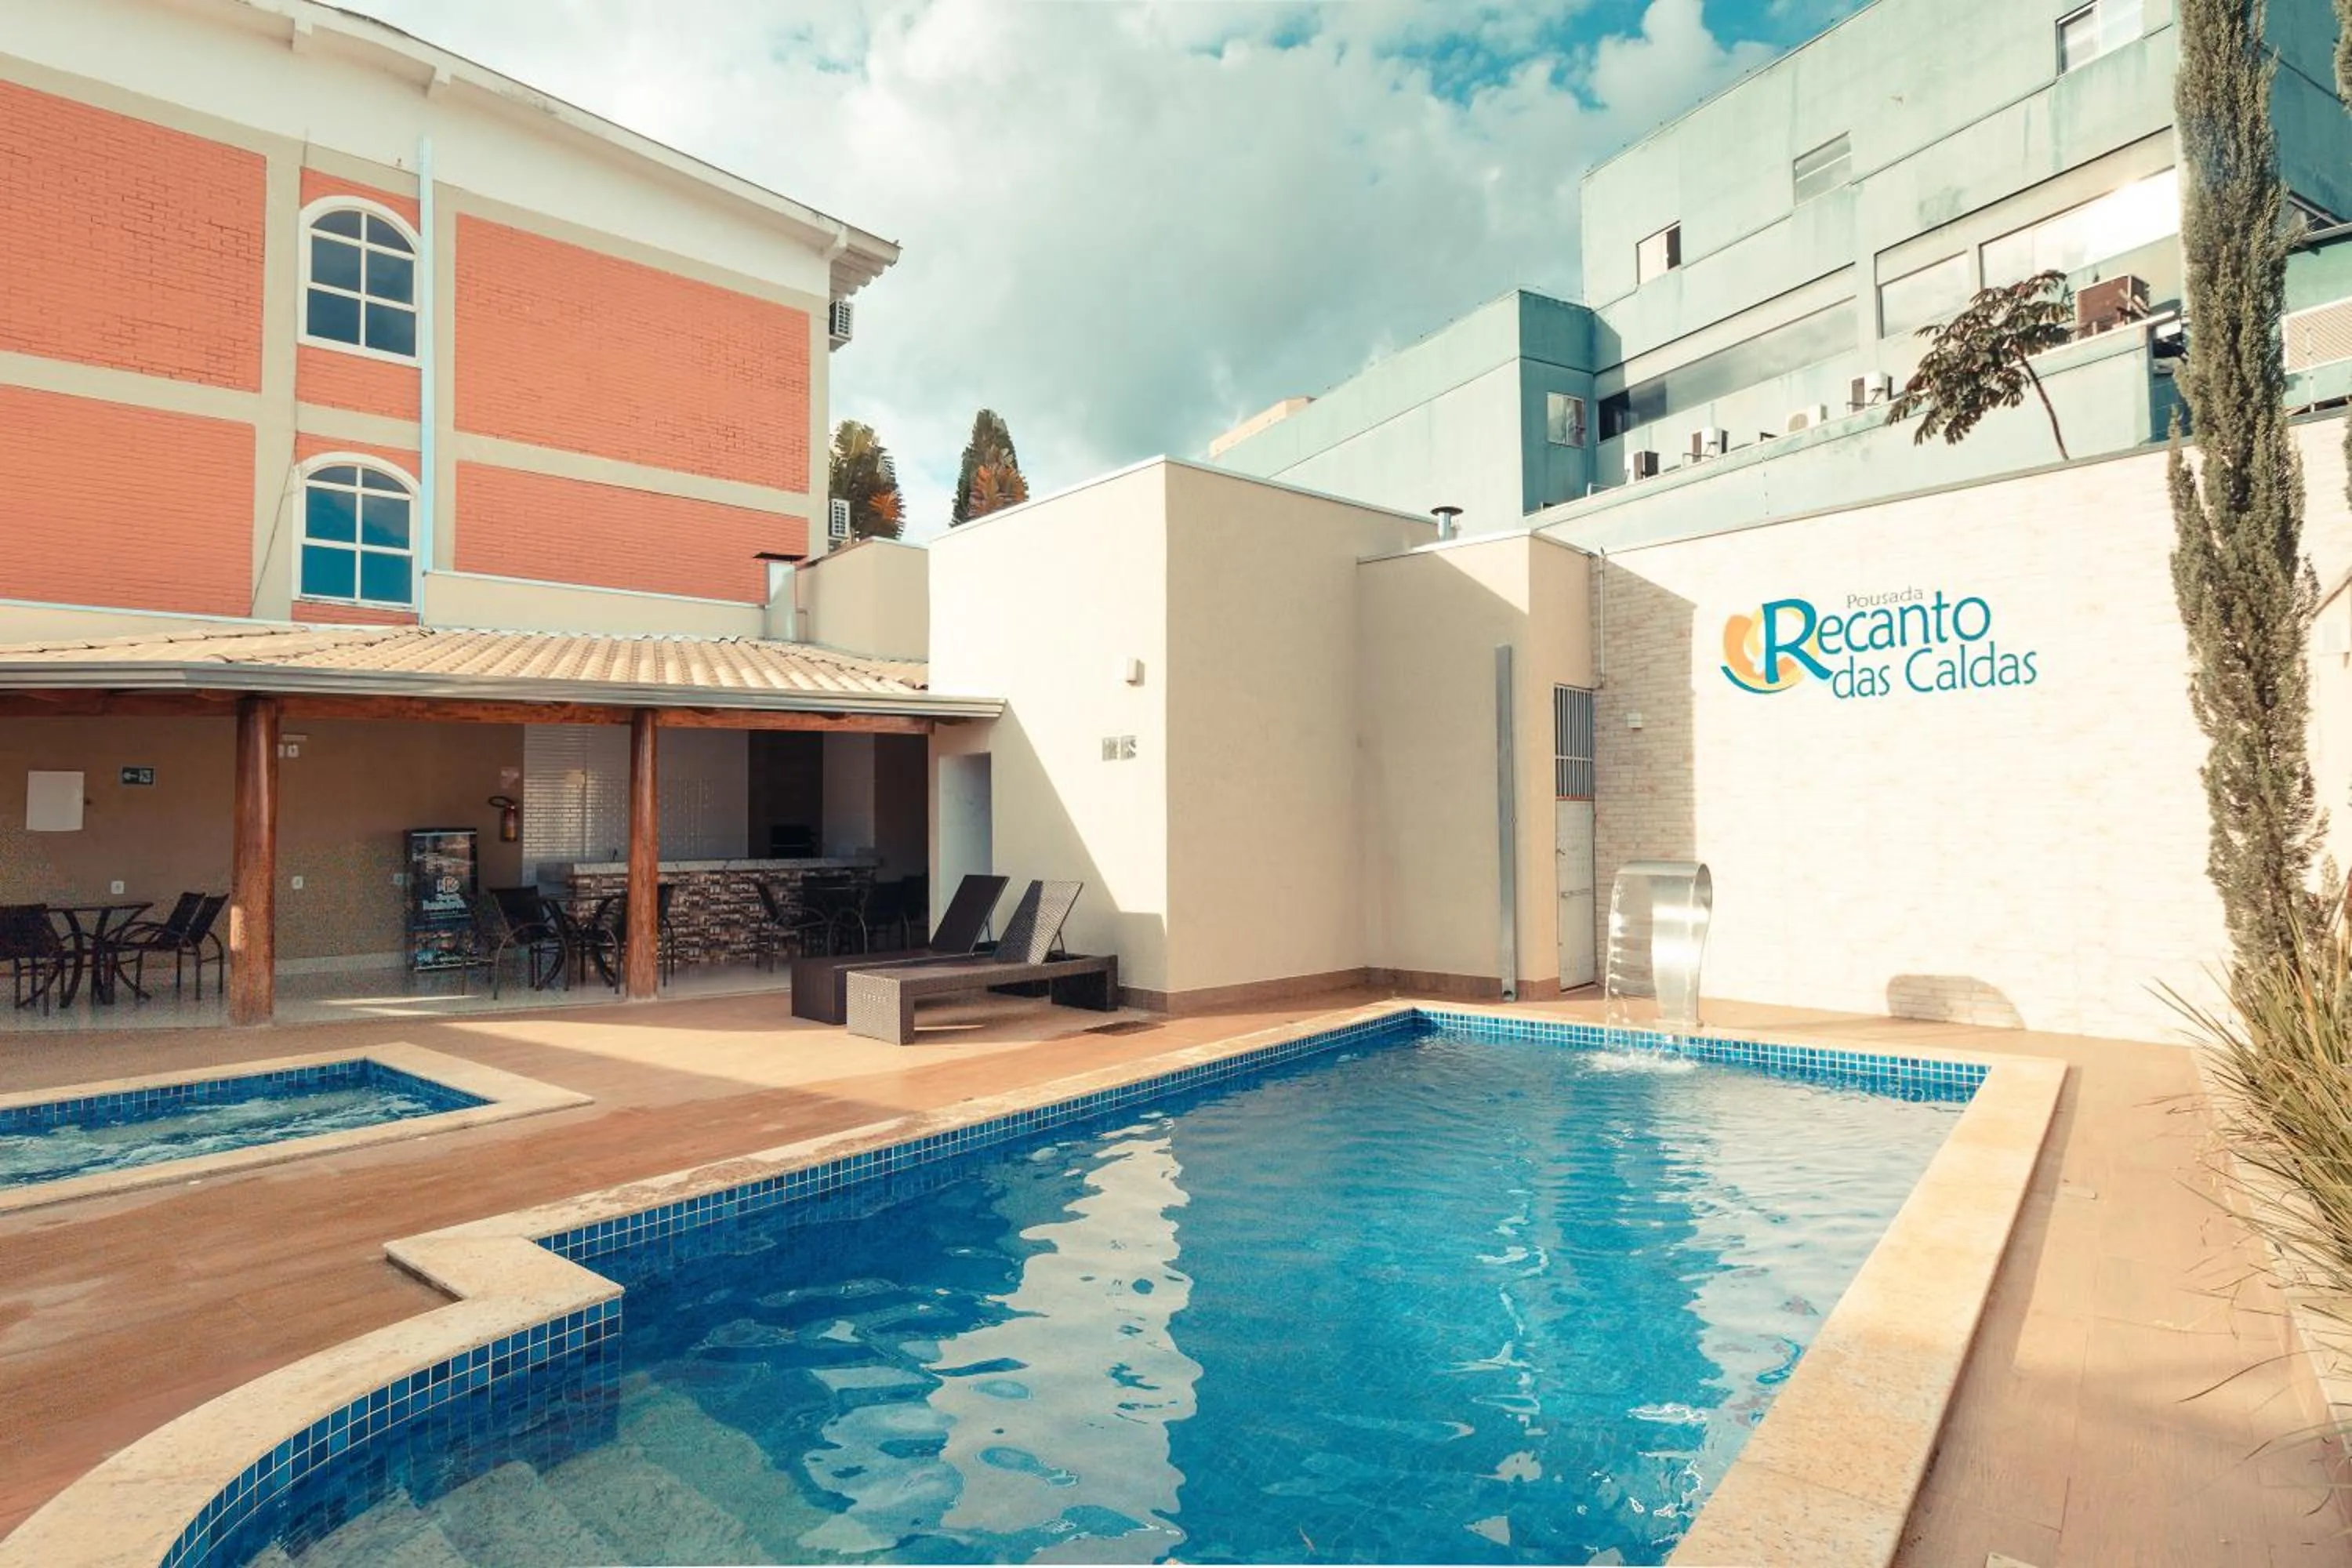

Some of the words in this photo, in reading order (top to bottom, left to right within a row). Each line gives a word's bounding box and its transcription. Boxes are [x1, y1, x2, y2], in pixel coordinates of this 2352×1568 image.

[1846, 586, 1924, 609] Pousada
[1761, 590, 1992, 685] Recanto
[1831, 655, 1891, 699] das
[1904, 641, 2038, 693] Caldas
